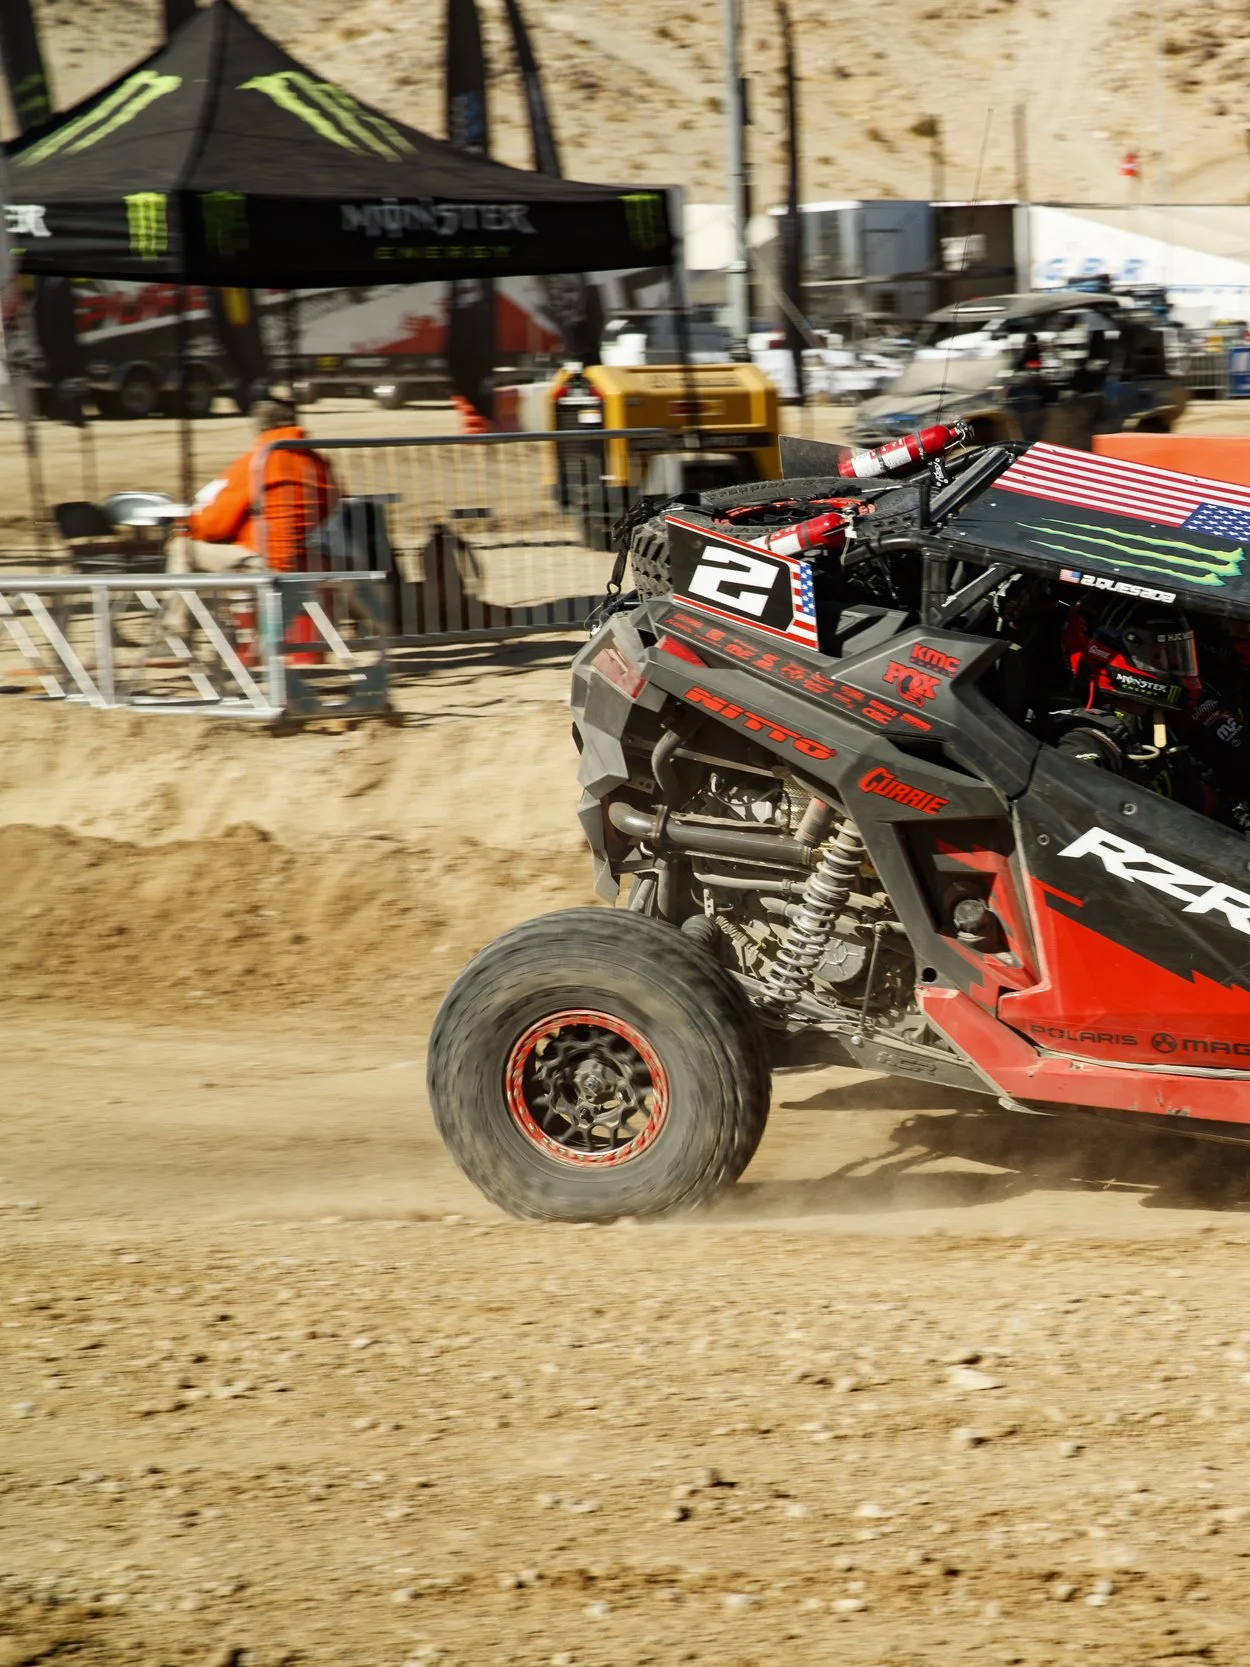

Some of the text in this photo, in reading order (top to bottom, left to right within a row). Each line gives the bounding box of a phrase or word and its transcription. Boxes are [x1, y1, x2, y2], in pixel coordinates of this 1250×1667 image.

[339, 197, 538, 238] MONSTER
[688, 545, 780, 617] 2
[911, 643, 961, 673] KMC
[882, 660, 942, 708] FOX
[1116, 673, 1168, 693] MONSTER
[684, 686, 837, 760] NITTO
[858, 765, 951, 816] CURRIE
[1030, 1024, 1139, 1046] POLARIS
